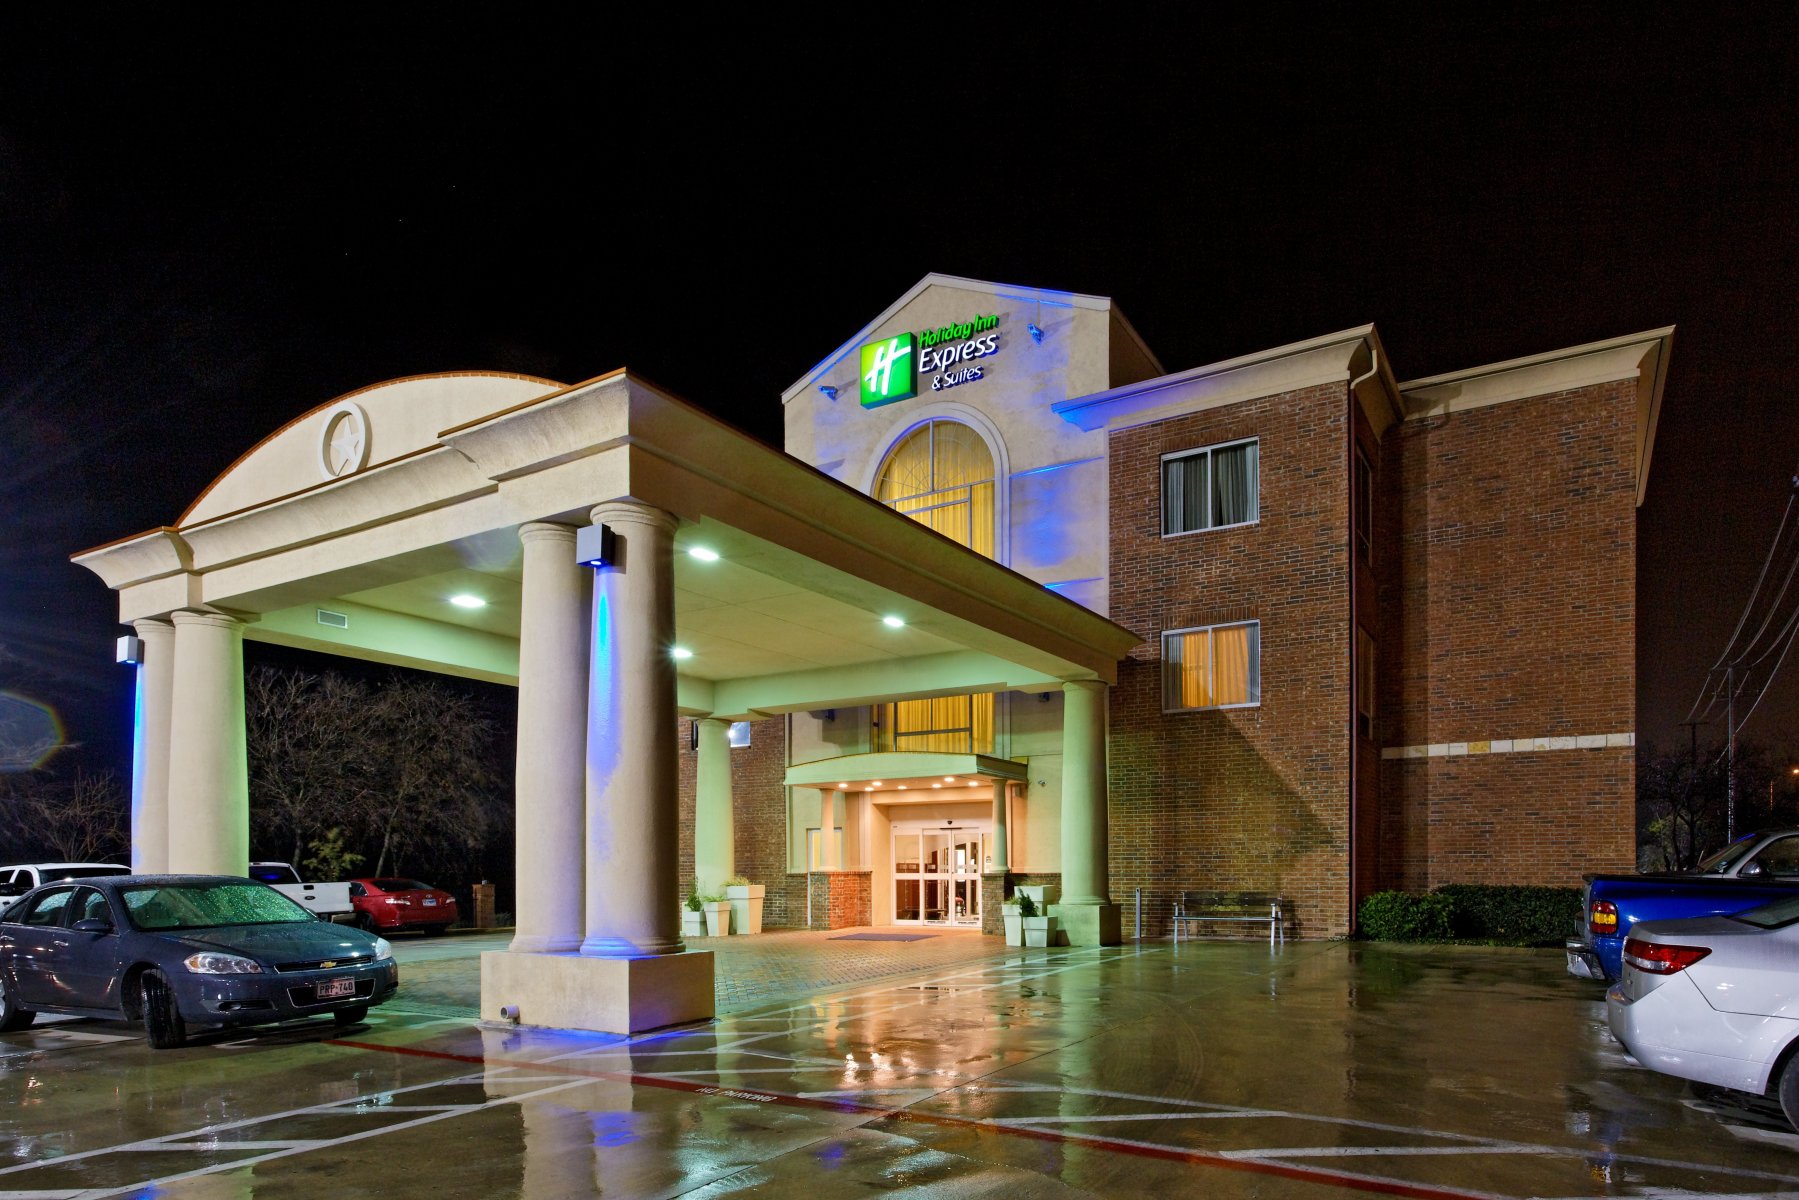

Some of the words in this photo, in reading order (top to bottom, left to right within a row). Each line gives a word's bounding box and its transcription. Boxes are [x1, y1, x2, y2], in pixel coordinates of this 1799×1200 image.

[919, 322, 972, 348] Holiday
[973, 314, 998, 330] Inn
[919, 334, 998, 372] Express
[931, 374, 942, 390] &
[943, 366, 982, 386] Suites
